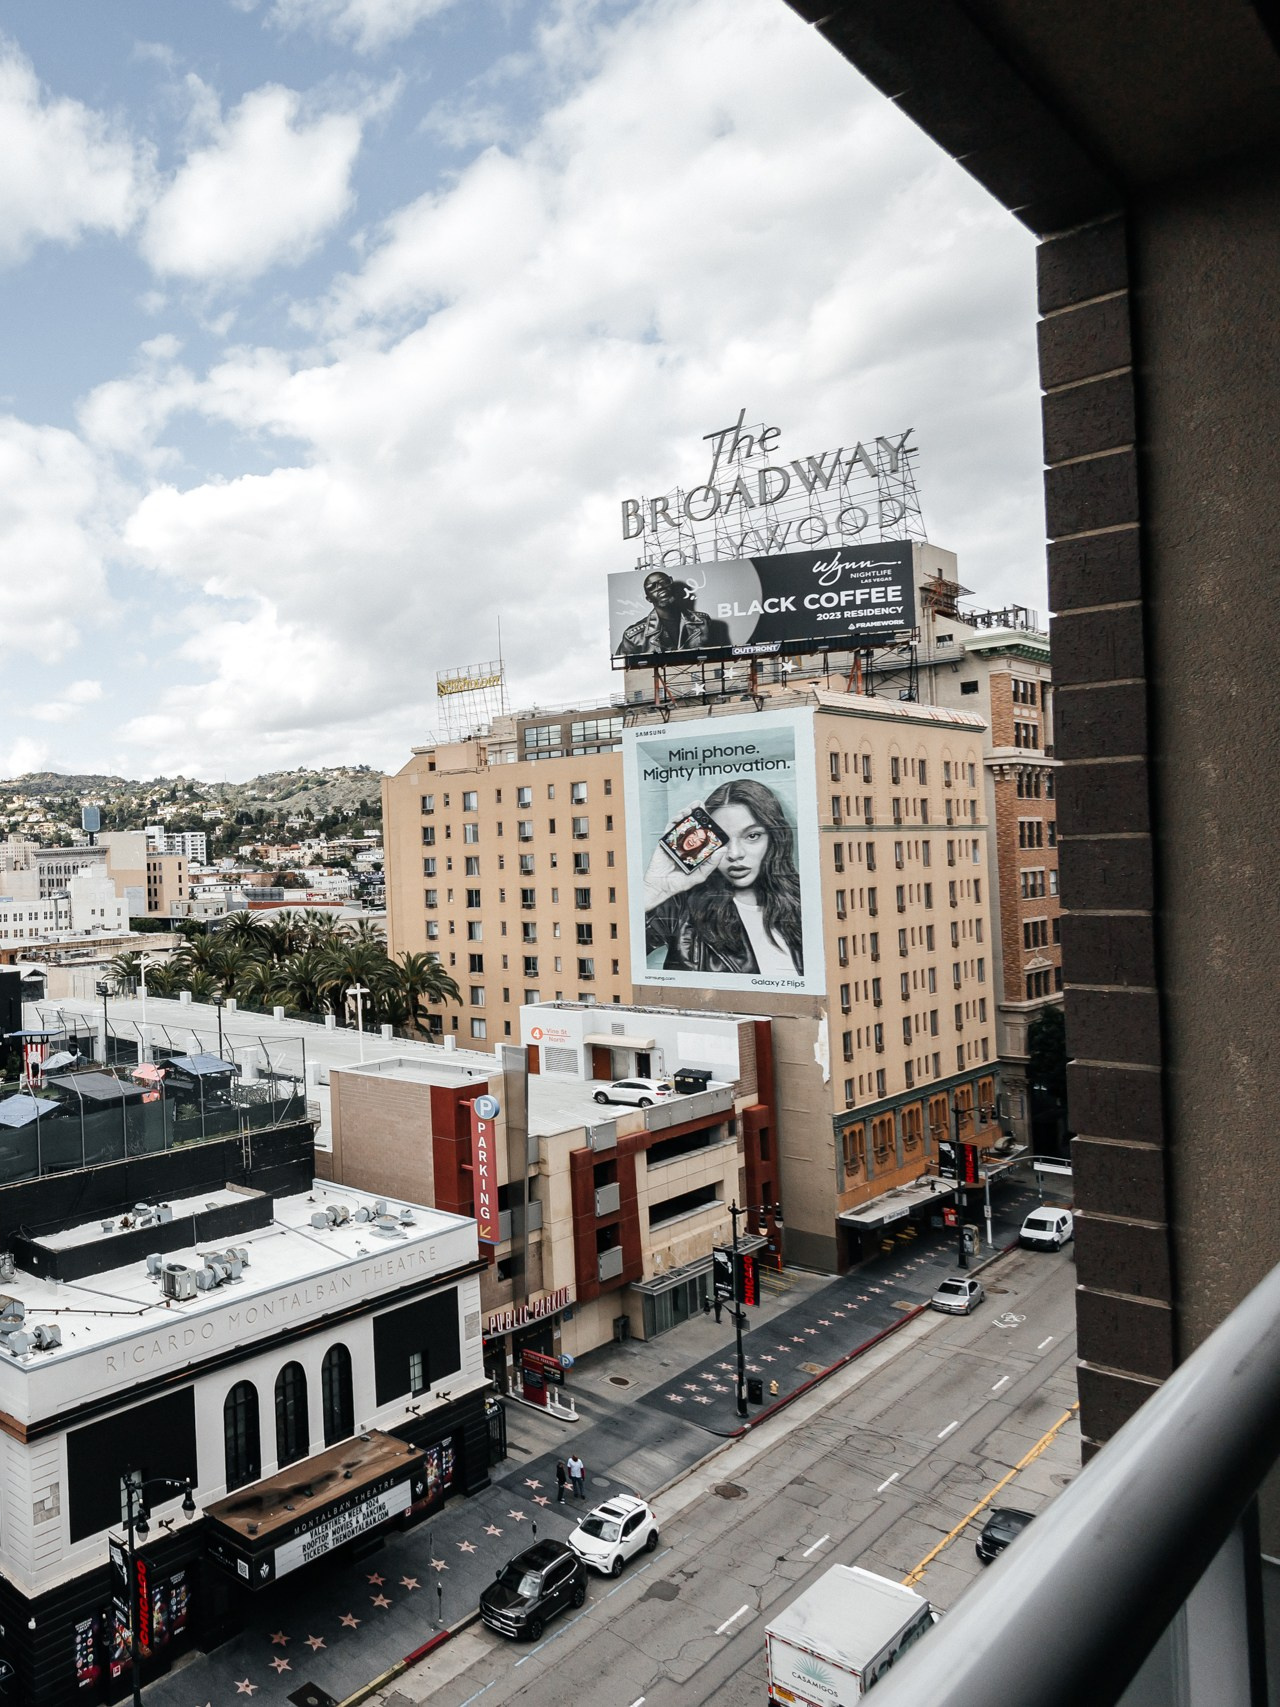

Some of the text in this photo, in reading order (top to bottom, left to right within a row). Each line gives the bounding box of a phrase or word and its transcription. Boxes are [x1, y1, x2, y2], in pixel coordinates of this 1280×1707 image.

[703, 408, 782, 502] The
[621, 428, 918, 540] BROADWAY
[850, 569, 892, 579] NIGHTLIFE
[717, 586, 902, 618] BLACK COFFEE
[816, 606, 904, 621] 2023 RESIDENCY
[855, 619, 905, 629] FRAMEWORK
[635, 729, 667, 738] SAMSUNG
[668, 744, 760, 764] Mini phone.
[643, 758, 791, 783] Mighty innovation.
[751, 978, 780, 988] Galaxy
[480, 1099, 491, 1115] P
[477, 1122, 491, 1220] PARKING
[743, 1255, 756, 1306] CHICAGO
[106, 1322, 214, 1374] RICARDO
[361, 1245, 438, 1283] THEATRE
[489, 1286, 572, 1335] PUBLIC PARKING
[354, 1478, 395, 1503] THEATRE
[302, 1530, 329, 1553] ROOFTOP
[331, 1519, 353, 1540] MOVIES
[362, 1502, 387, 1521] DANCING
[309, 1498, 379, 1539] VALENTINE'S WEEK 2024
[303, 1510, 389, 1563] TICKETS: THEMONTALBAN.COM
[136, 1559, 149, 1646] CHICAGO
[791, 1671, 839, 1698] CASAMIGOS
